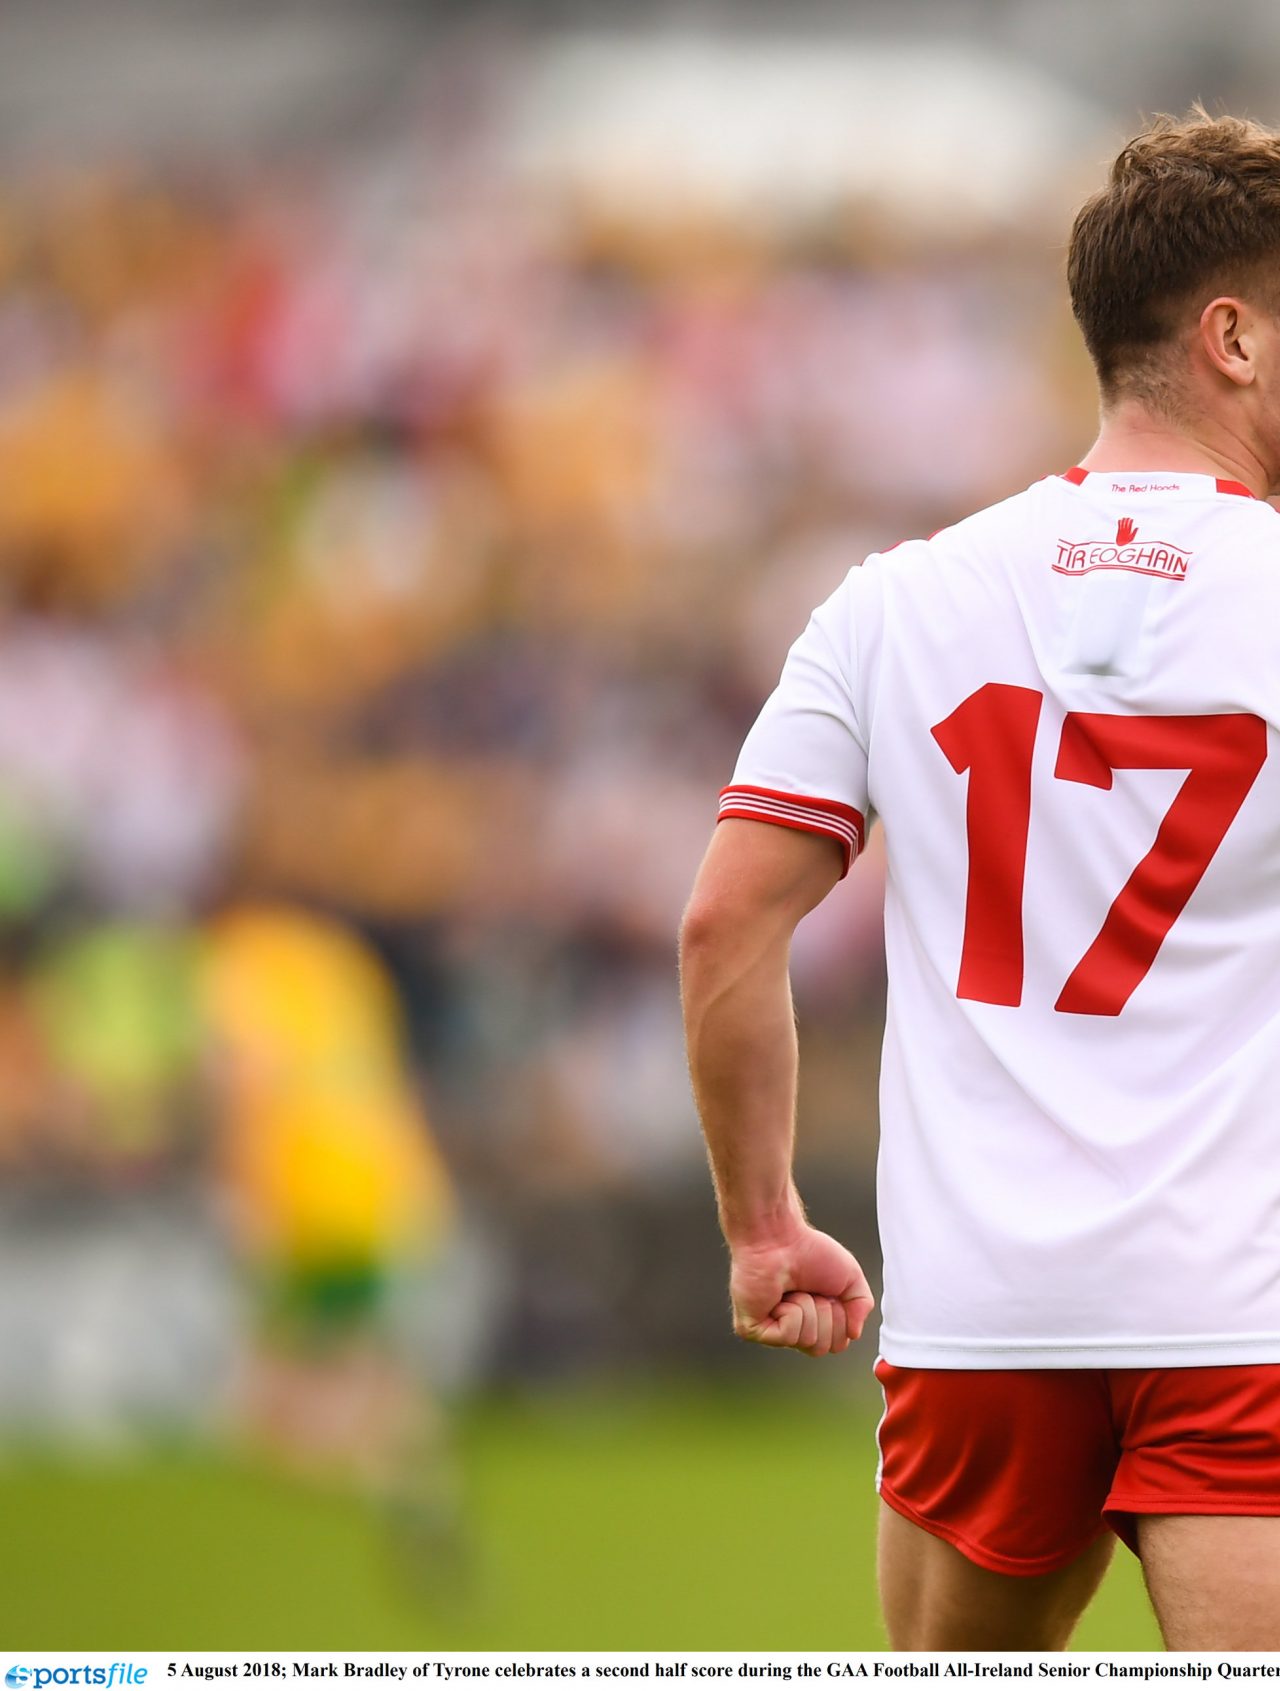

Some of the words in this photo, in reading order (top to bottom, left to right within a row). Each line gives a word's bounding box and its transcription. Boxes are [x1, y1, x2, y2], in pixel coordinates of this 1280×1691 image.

[1111, 484, 1127, 493] The
[1128, 484, 1147, 493] Red
[1149, 483, 1181, 492] Hands
[930, 681, 1269, 1017] 17
